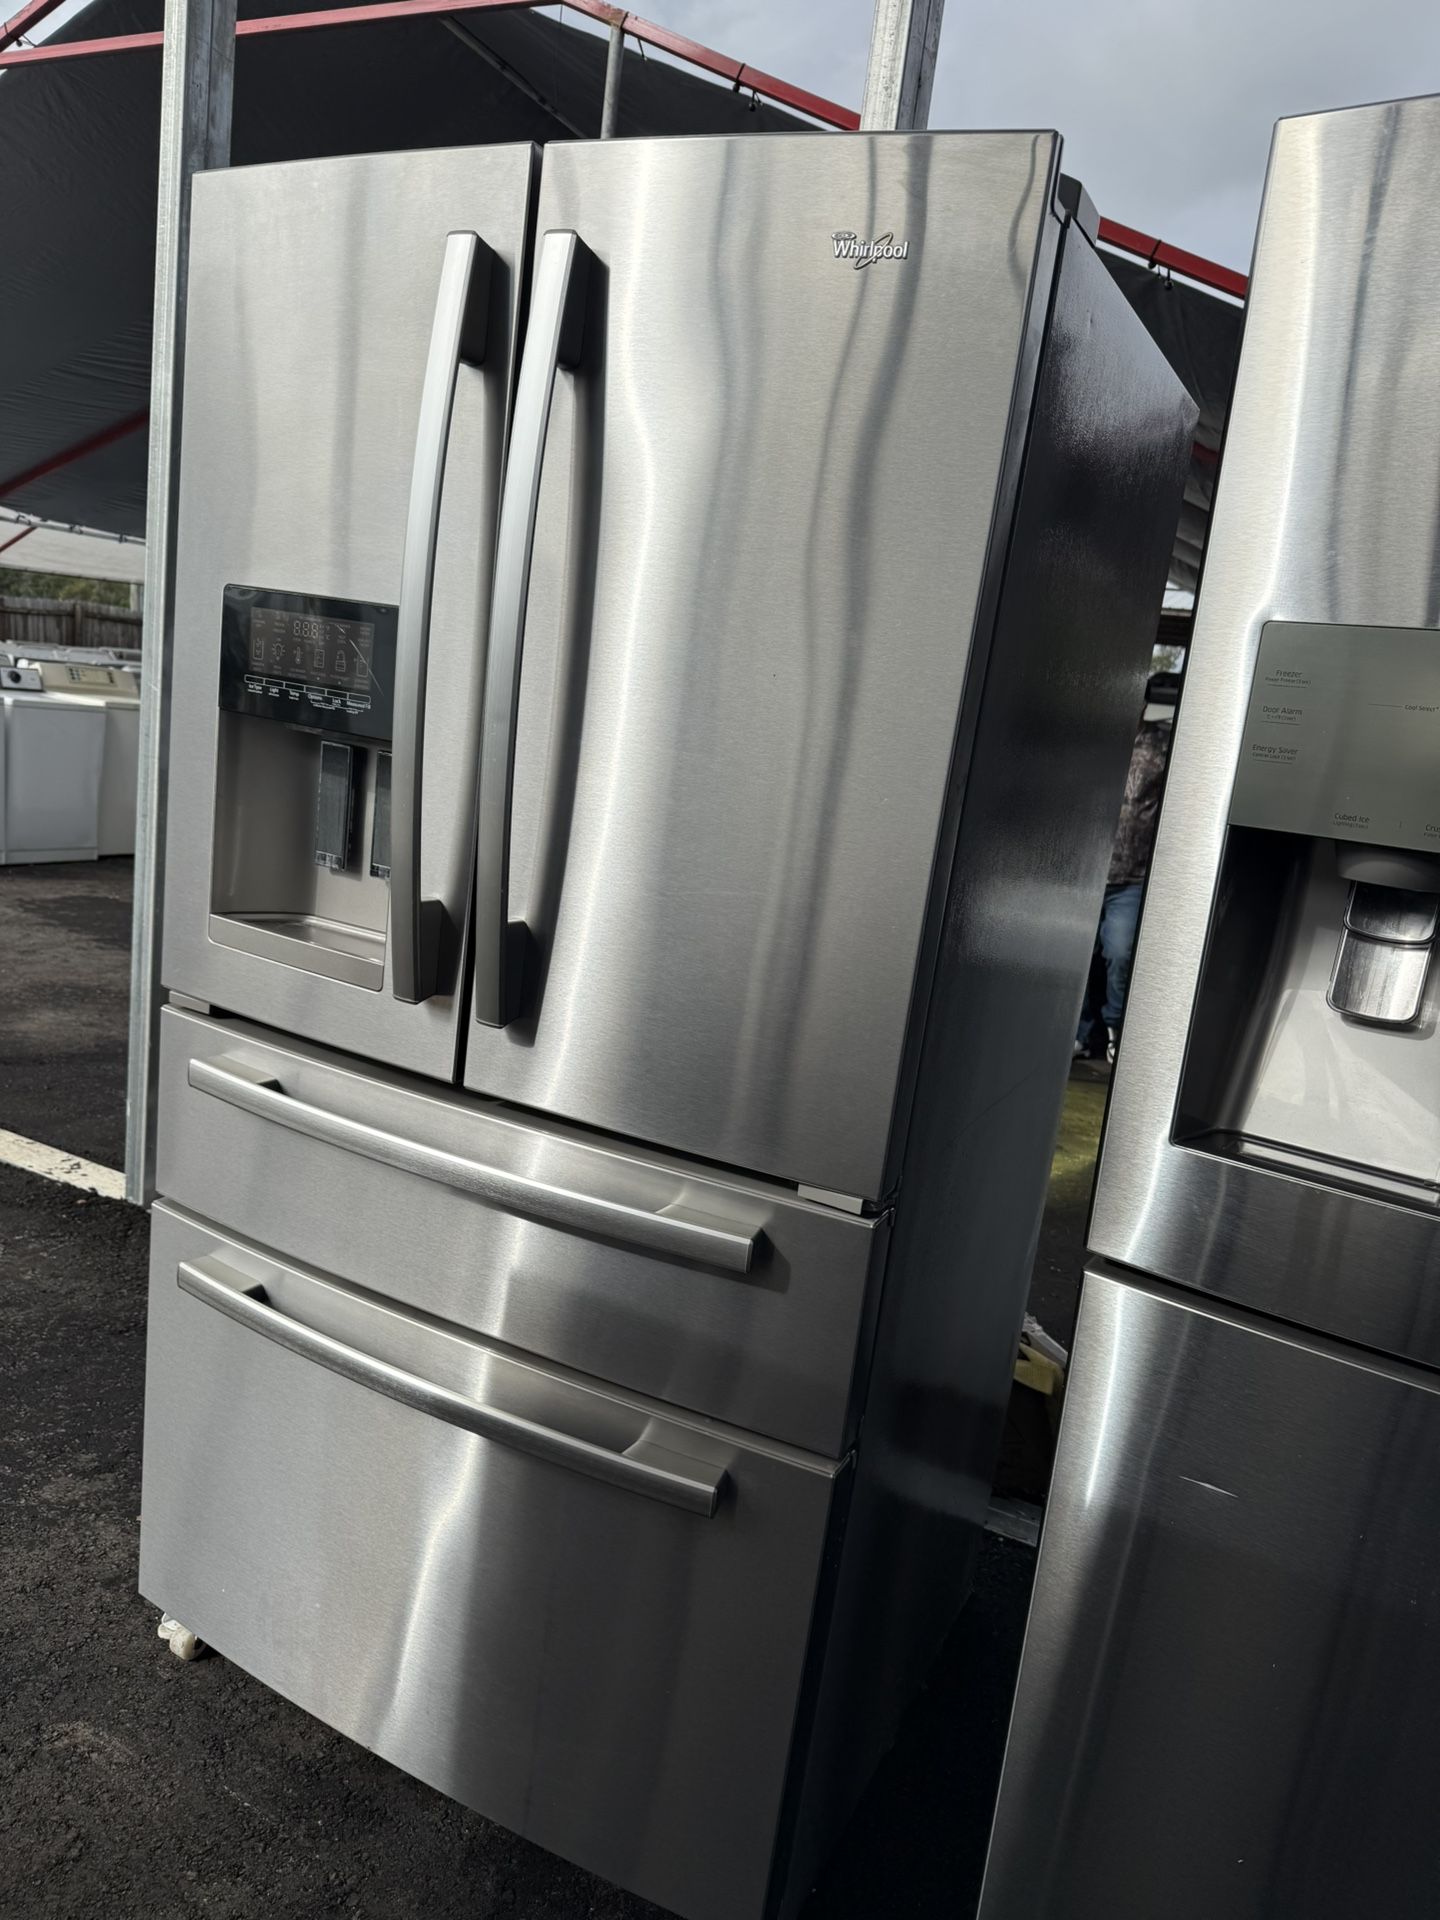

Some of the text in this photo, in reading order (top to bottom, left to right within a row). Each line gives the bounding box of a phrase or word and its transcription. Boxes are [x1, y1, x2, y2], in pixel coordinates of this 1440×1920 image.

[833, 239, 909, 263] Whirlpool
[1276, 669, 1303, 678] Freezer
[1262, 705, 1303, 716] Door Alarm
[1252, 744, 1298, 755] Energy Saver
[1334, 813, 1370, 823] Cubed Ice
